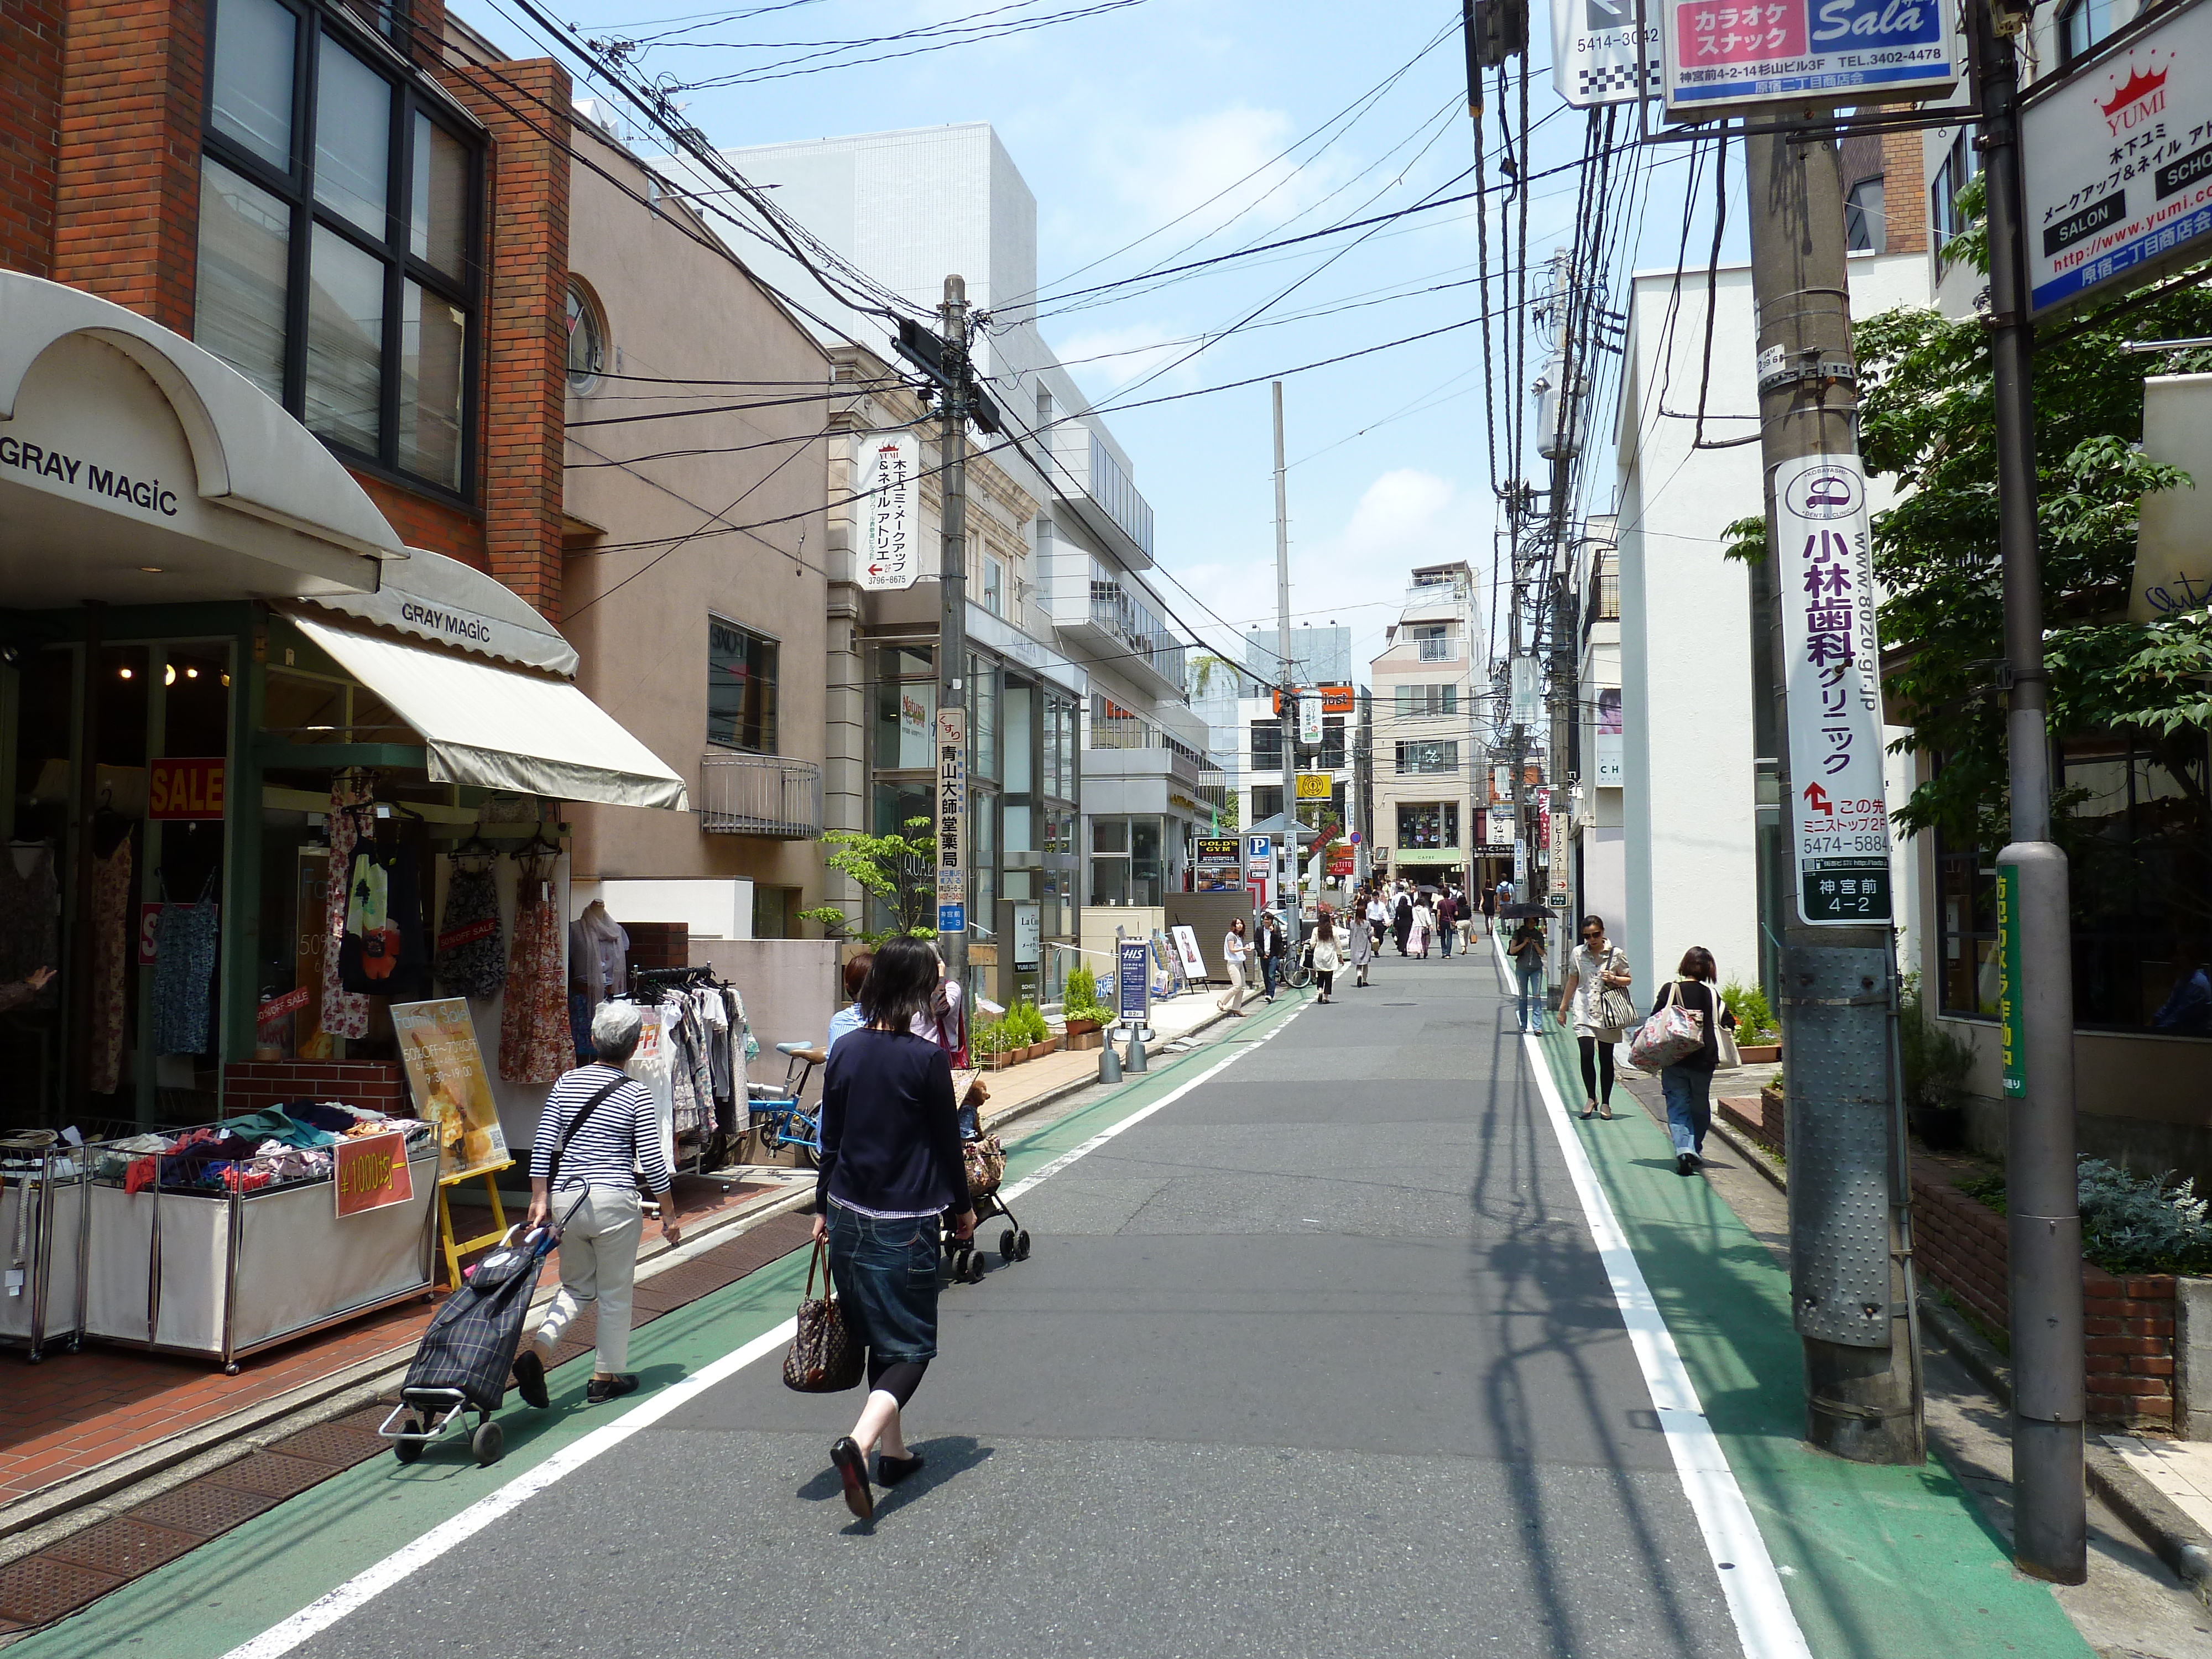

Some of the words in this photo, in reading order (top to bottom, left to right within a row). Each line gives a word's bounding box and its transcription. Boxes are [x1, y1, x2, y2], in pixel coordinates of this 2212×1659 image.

[1695, 3, 1787, 32] カラオケ
[1812, 0, 1924, 41] Sala
[1697, 28, 1786, 56] スナック
[1838, 48, 1942, 67] TEL.3402-4478
[1755, 72, 1864, 94] 原宿二丁目商店会
[2106, 89, 2166, 138] YUMI
[2110, 123, 2166, 165] 木下ユミ
[2059, 205, 2109, 242] SALON
[2081, 211, 2211, 287] 原宿二丁目商店会
[0, 436, 82, 484] GRAY
[1806, 467, 1846, 477] KOBAYASHI
[1805, 510, 1831, 519] DENTAL
[1832, 508, 1852, 518] CLINIC
[868, 575, 906, 585] 3796-8675
[885, 564, 891, 573] 2F
[402, 603, 443, 629] GRAY
[1854, 532, 1877, 712] www.8020.gr.jp
[1802, 529, 1856, 775] 小林歯科クリニック
[939, 715, 961, 740] くすり
[150, 768, 224, 812] SALE
[941, 745, 957, 868] 青山大師堂薬局
[1840, 799, 1885, 814] この先
[1253, 838, 1266, 854] P
[1804, 836, 1888, 854] 5474-5884
[1819, 878, 1877, 895] 神宮前
[1829, 897, 1870, 912] 4-2
[441, 930, 471, 947] 50%OFF
[473, 922, 494, 936] SALE
[286, 992, 308, 1007] SALE
[441, 1005, 469, 1024] Sale
